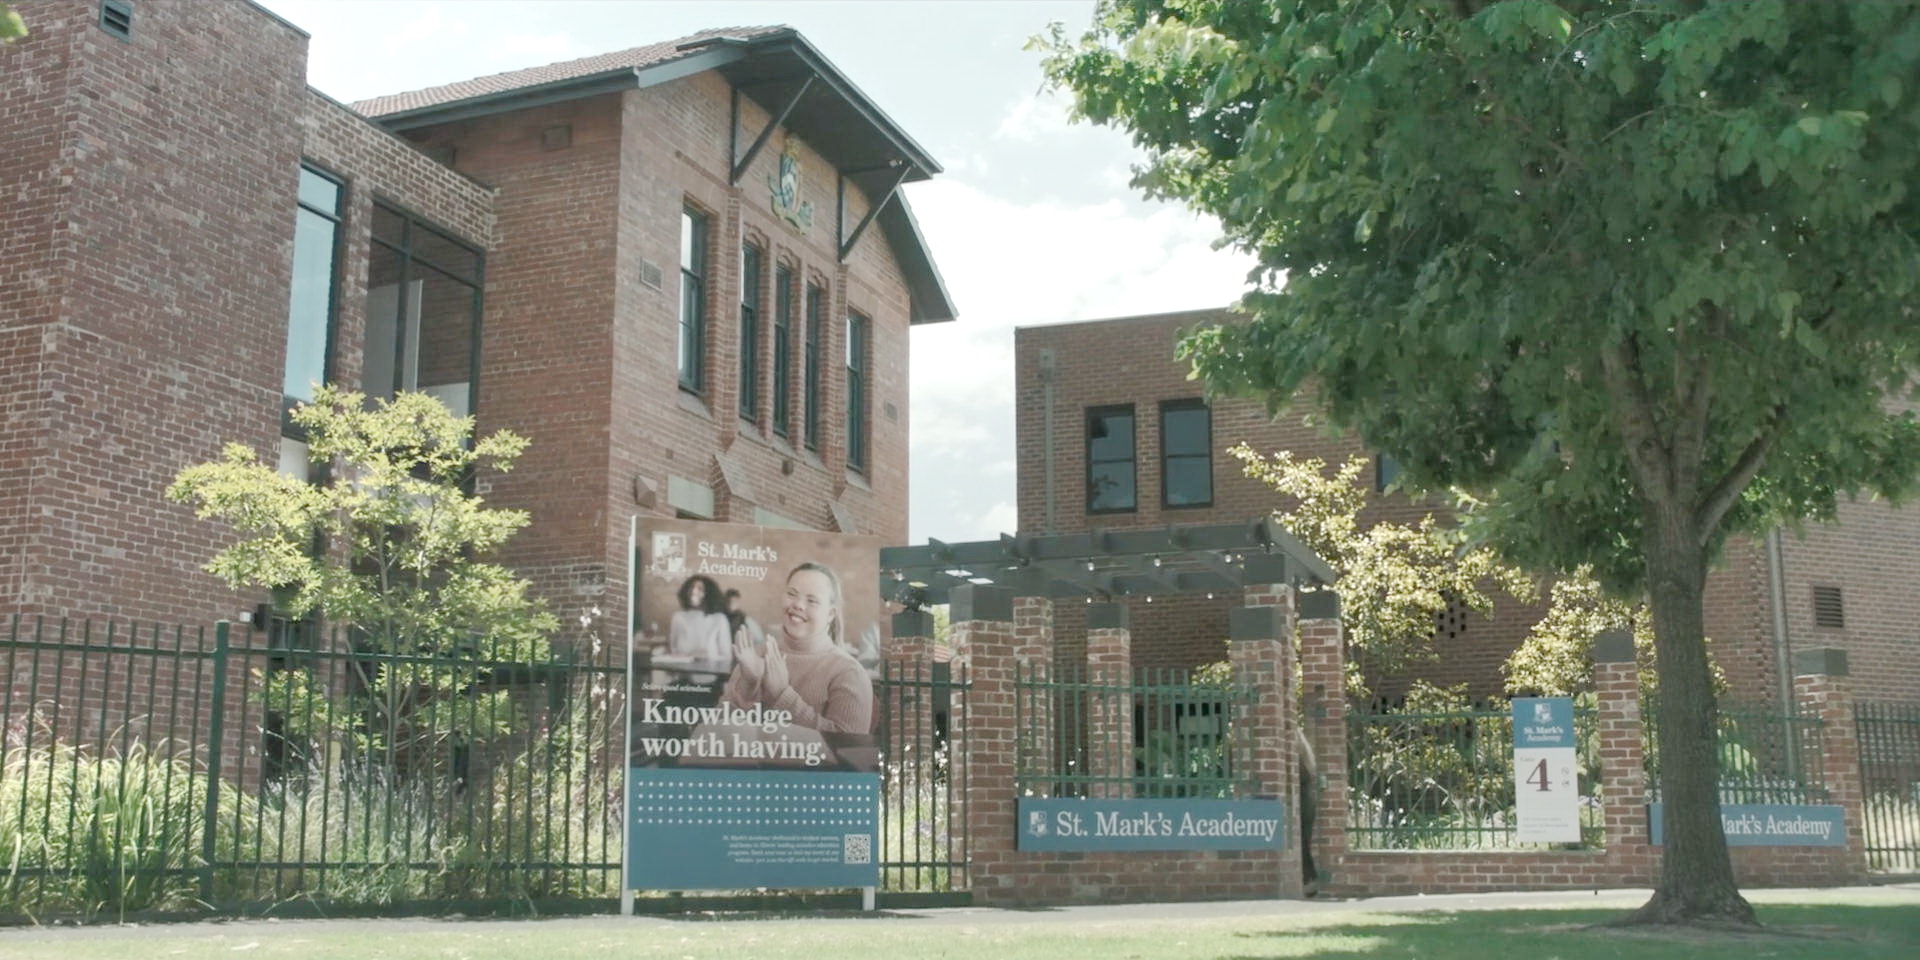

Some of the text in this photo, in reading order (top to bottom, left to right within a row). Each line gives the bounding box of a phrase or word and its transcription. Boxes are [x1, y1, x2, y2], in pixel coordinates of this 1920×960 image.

[698, 541, 778, 562] St. Mark's
[698, 559, 769, 581] Academy
[641, 698, 793, 734] Knowledge
[641, 733, 827, 767] worth having.
[1526, 757, 1553, 792] 4
[1056, 811, 1278, 842] St. Mark's Academy
[1765, 814, 1832, 841] Academy
